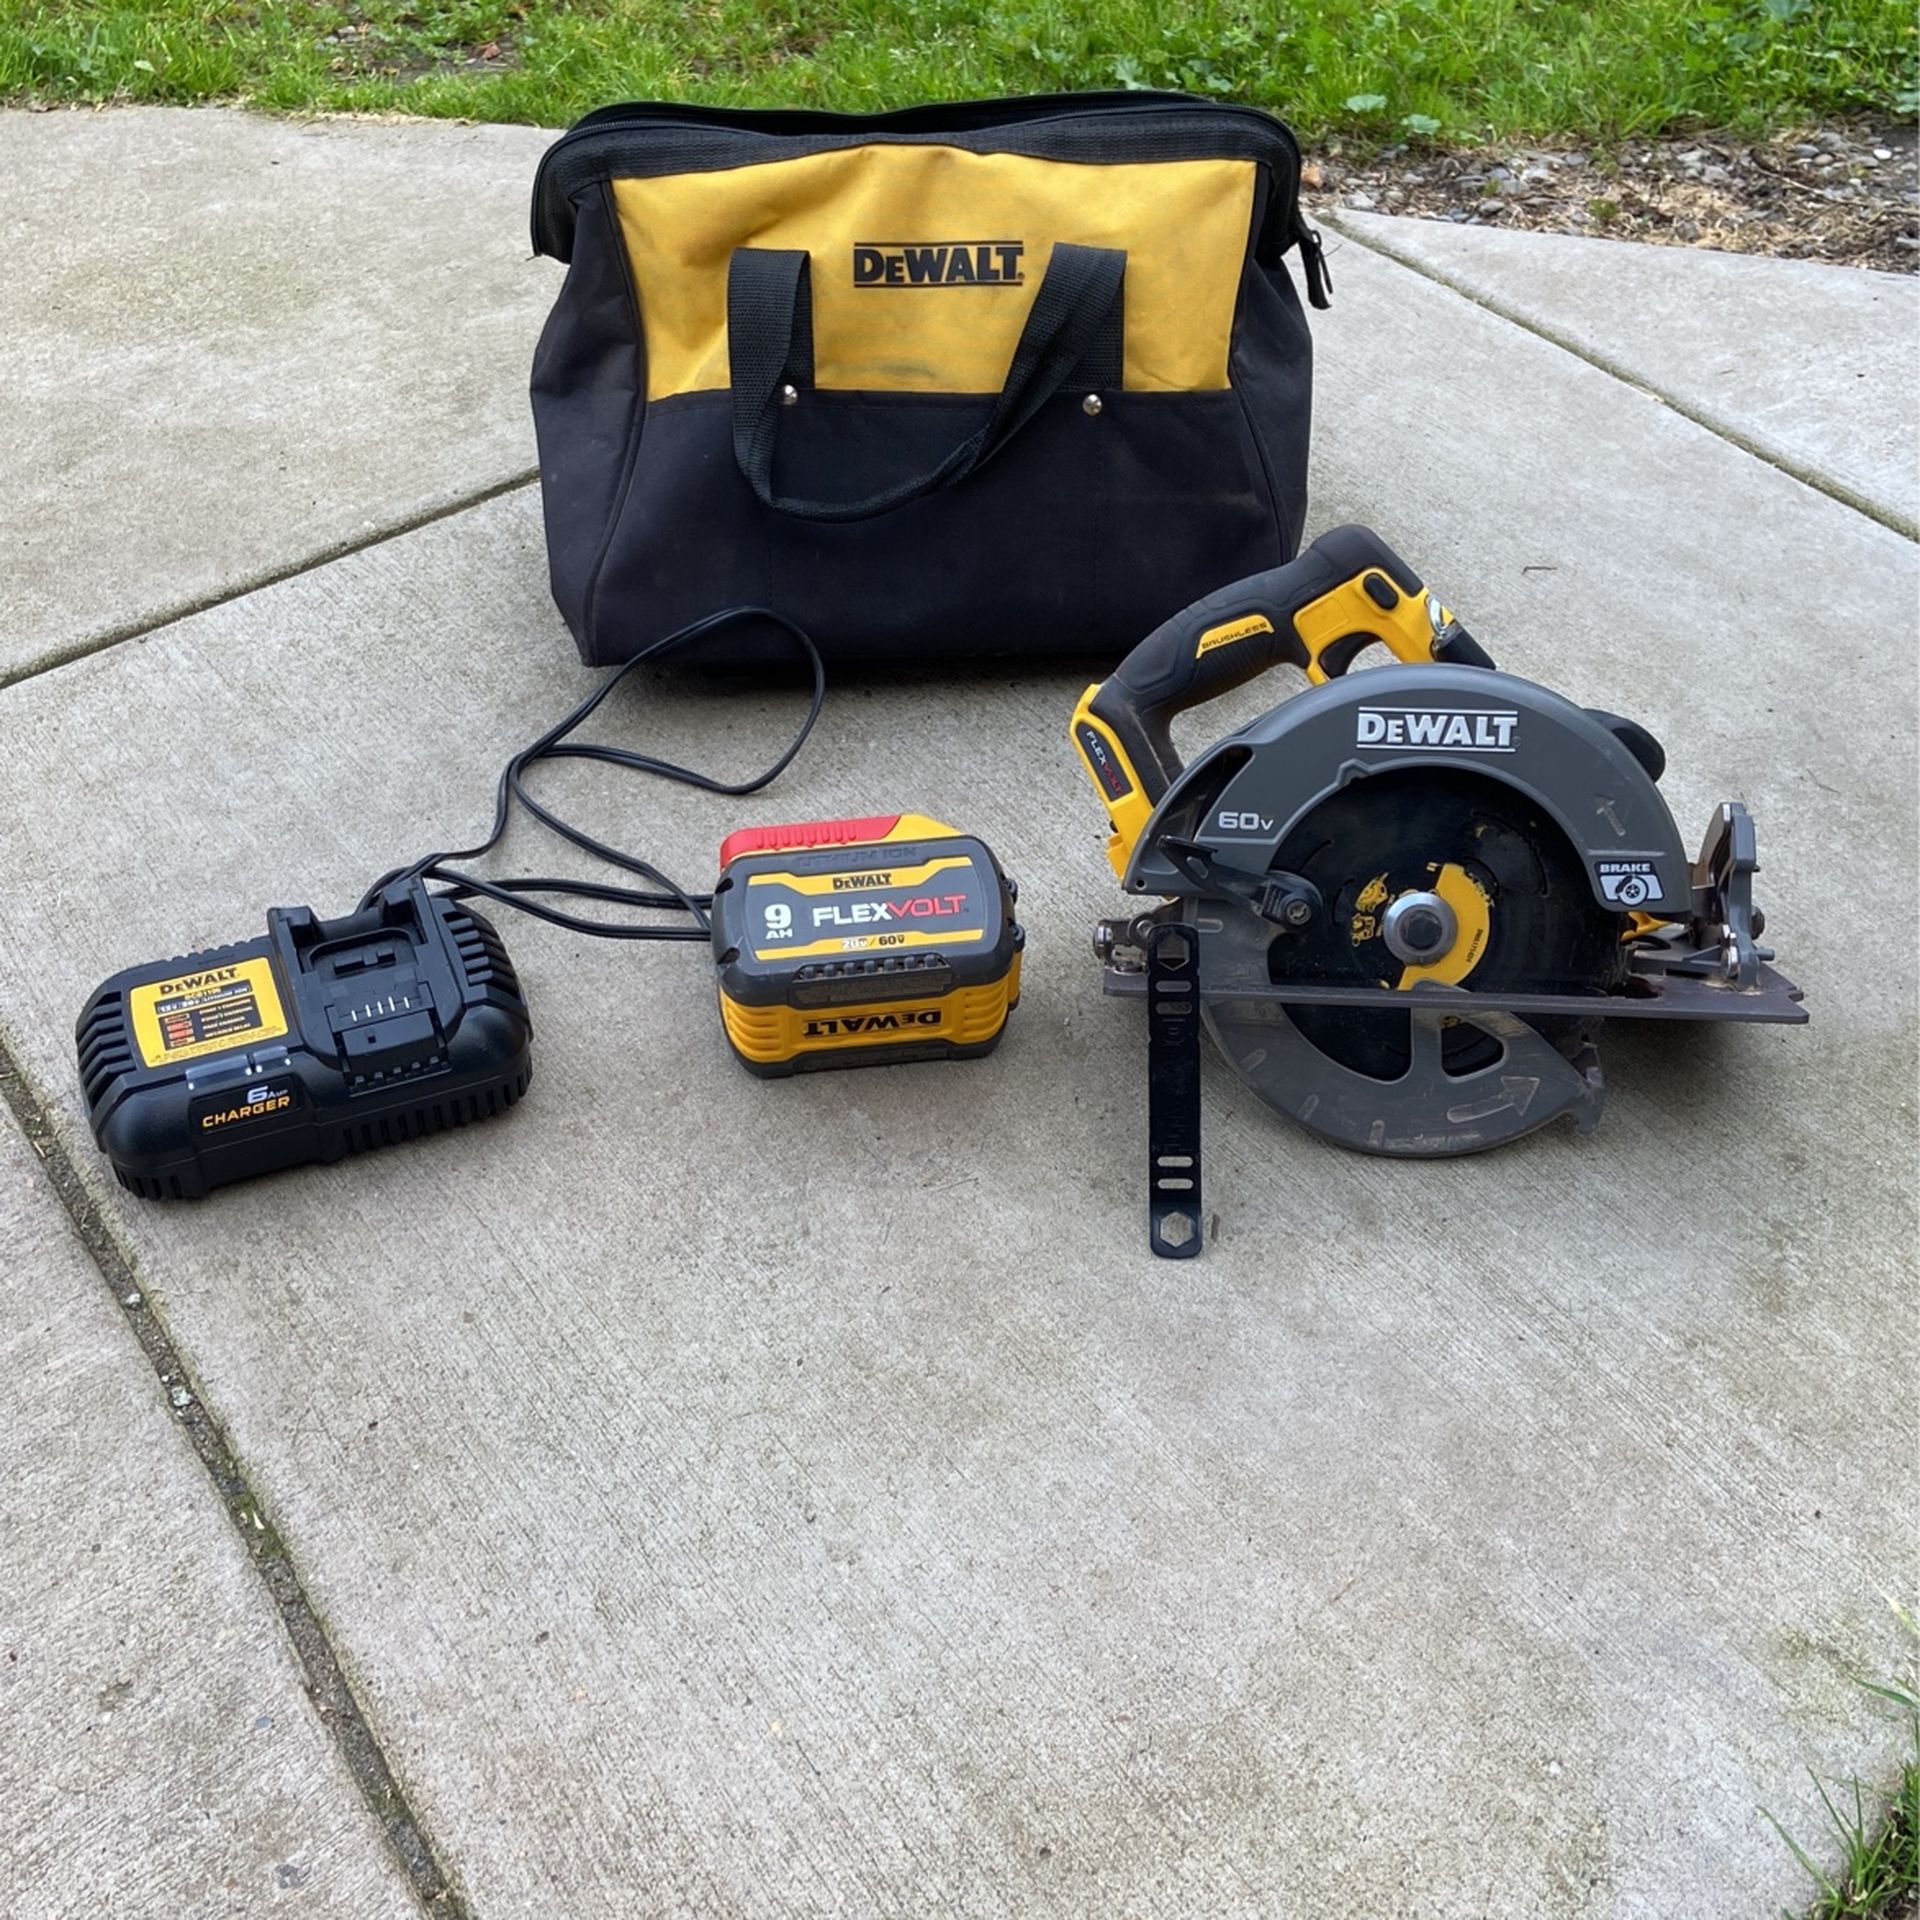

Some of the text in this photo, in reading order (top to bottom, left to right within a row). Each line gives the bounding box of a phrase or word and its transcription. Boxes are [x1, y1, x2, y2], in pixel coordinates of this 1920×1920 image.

[854, 246, 1023, 284] DEWALT
[1201, 621, 1267, 649] BRUSHLESS
[1357, 712, 1518, 747] DEWALT
[1085, 730, 1124, 796] FLEXVOLT
[833, 872, 892, 891] DEWALT
[1600, 863, 1651, 873] BRAKE
[764, 903, 792, 929] 9
[812, 894, 966, 927] FLEXVOLT
[160, 967, 237, 995] DEWALT
[804, 1010, 942, 1036] DEWALT
[247, 1085, 269, 1104] 6
[203, 1096, 291, 1128] CHARGER
